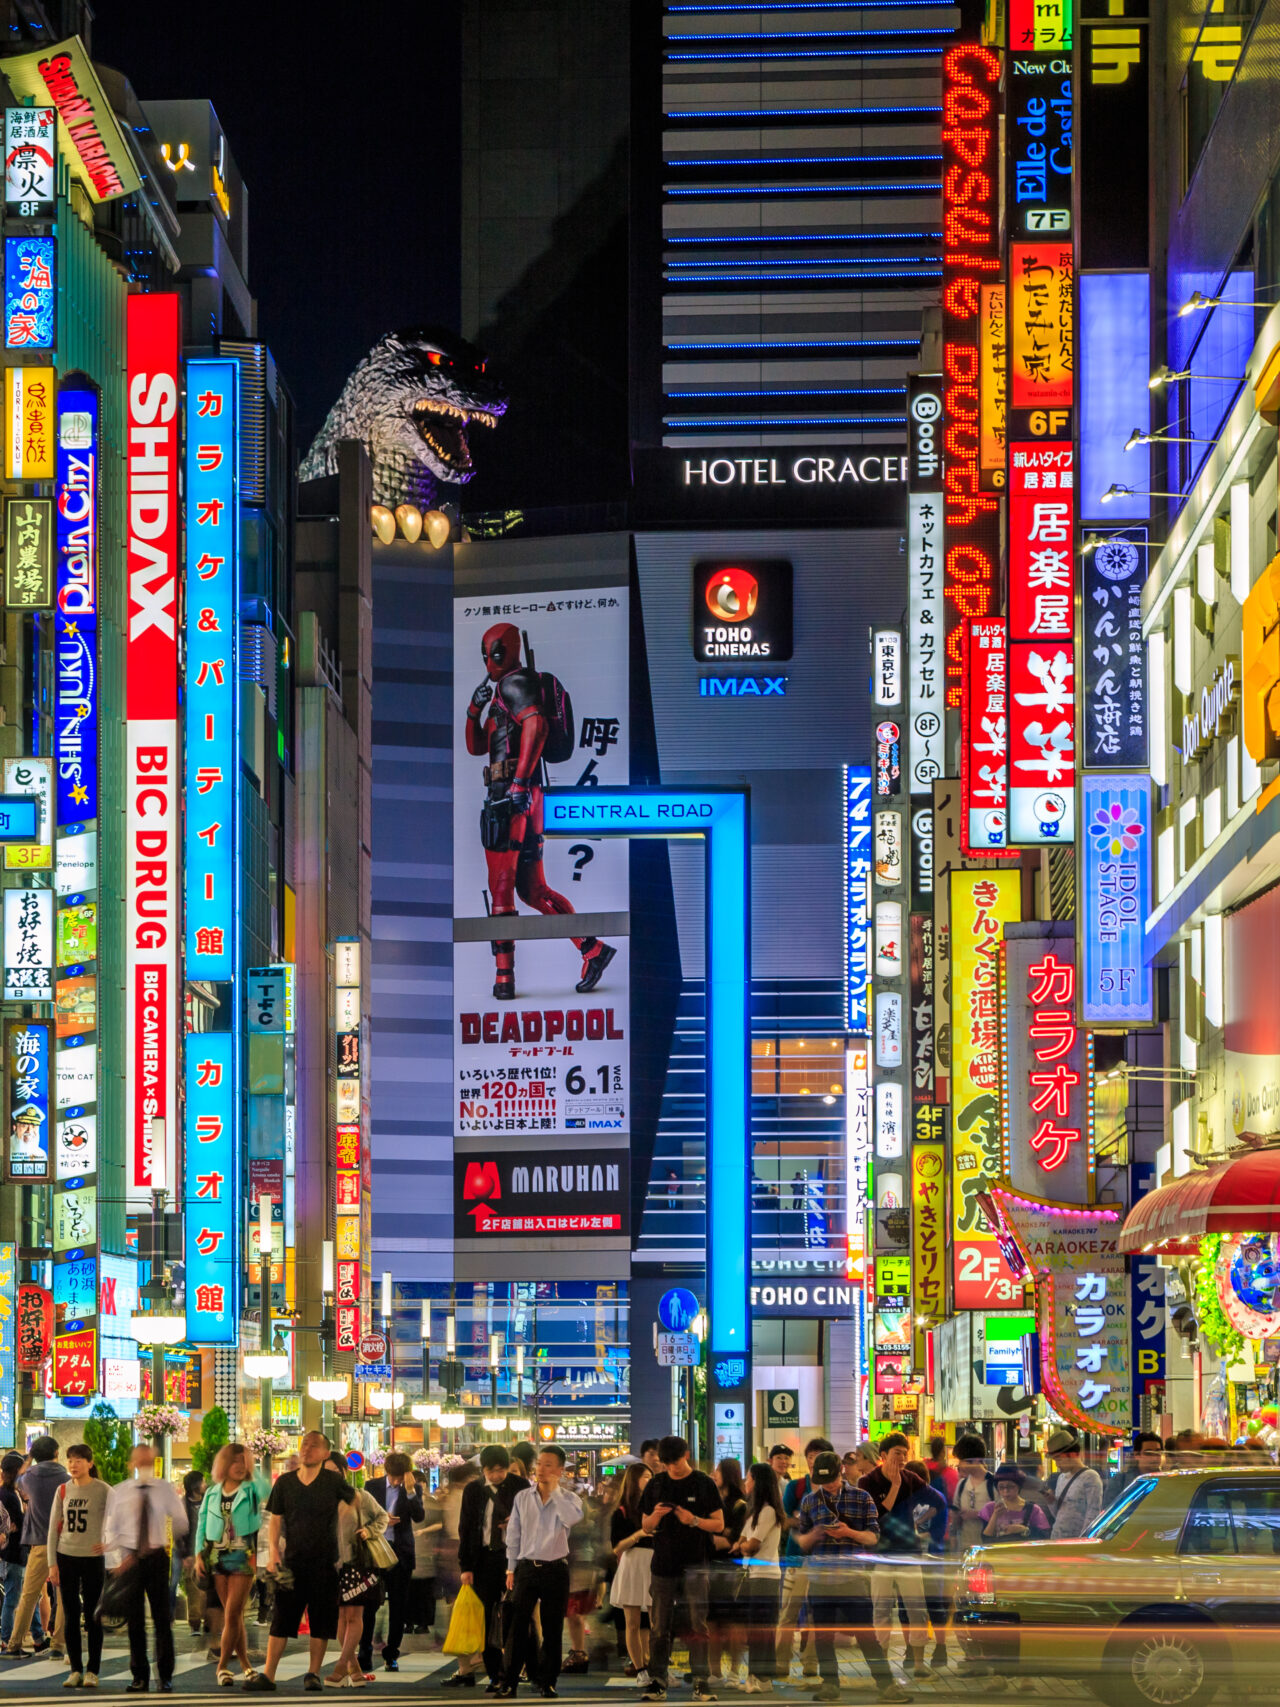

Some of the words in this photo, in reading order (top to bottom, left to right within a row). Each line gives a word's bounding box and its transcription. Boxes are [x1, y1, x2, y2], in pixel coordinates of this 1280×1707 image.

[1013, 60, 1046, 75] New
[10, 112, 36, 125] 海鮮
[1017, 97, 1046, 137] de
[10, 126, 50, 139] 居酒屋
[942, 44, 1001, 319] Capsule
[1017, 142, 1046, 203] Elle
[19, 202, 39, 217] 8F
[1032, 213, 1066, 229] 7F
[8, 256, 51, 346] 海の家
[1022, 256, 1054, 383] わたみん家
[912, 393, 941, 477] Booth
[1029, 411, 1069, 435] 6F
[684, 459, 787, 485] HOTEL
[1013, 451, 1073, 468] 新しいタイプ
[1024, 471, 1073, 489] 居酒屋
[130, 373, 177, 642] SHIDAX
[13, 504, 44, 593] 山内農場
[919, 503, 936, 600] ネットカフェ
[1027, 503, 1071, 636] 居楽屋
[22, 592, 36, 604] 5F
[919, 610, 935, 625] &
[705, 627, 753, 642] TOHO
[705, 642, 771, 657] CINEMAS
[196, 390, 225, 956] カラオケ&パーティー館
[881, 645, 896, 700] 東京ビル
[919, 632, 936, 700] カプセル
[1092, 585, 1122, 756] かんかん商店
[699, 676, 787, 697] IMAX
[59, 641, 92, 780] SHINJUKU
[1014, 651, 1074, 783] 笑笑
[1182, 710, 1200, 766] Don
[1201, 659, 1236, 739] Quijote
[135, 747, 168, 817] BIC
[554, 804, 650, 819] CENTRAL
[658, 803, 713, 818] ROAD
[848, 776, 871, 849] 747
[18, 848, 40, 863] 3F
[57, 860, 94, 870] Penelope
[61, 885, 72, 893] 7F
[135, 830, 168, 950] DRUG
[1099, 862, 1119, 943] STAGE
[1118, 863, 1138, 929] IDOL
[18, 892, 42, 966] お好み焼
[6, 968, 50, 987] 大阪家
[970, 880, 999, 1051] きんくら酒場
[1099, 967, 1136, 991] 5F
[143, 970, 158, 1002] BIC
[460, 1008, 624, 1044] DEADPOOL
[16, 1031, 41, 1100] 海の家
[508, 1046, 574, 1057] デッドプール
[973, 1055, 998, 1066] KIN
[1028, 953, 1080, 1172] カラオケ
[57, 1073, 74, 1081] TOM
[77, 1073, 94, 1081] CAT
[565, 1065, 609, 1096] 6.1
[979, 1065, 994, 1075] no
[588, 1120, 623, 1129] IMAX
[916, 1106, 942, 1122] 4F
[916, 1124, 942, 1140] 3F
[338, 1133, 358, 1164] 麻雀
[195, 1059, 223, 1314] カラオケ館
[511, 1164, 620, 1193] MARUHAN
[482, 1216, 613, 1231] 2F店舗出入口はビル左側
[81, 1262, 95, 1291] 砂浜
[959, 1247, 1001, 1284] 2F
[67, 1262, 80, 1318] あります
[751, 1287, 808, 1305] TOHO
[362, 1341, 385, 1354] 消火栓
[1074, 1272, 1111, 1410] カラオケ
[58, 1355, 91, 1368] アダム
[64, 1380, 86, 1393] イヴ
[1004, 1369, 1020, 1384] 酒
[67, 1509, 88, 1533] 85
